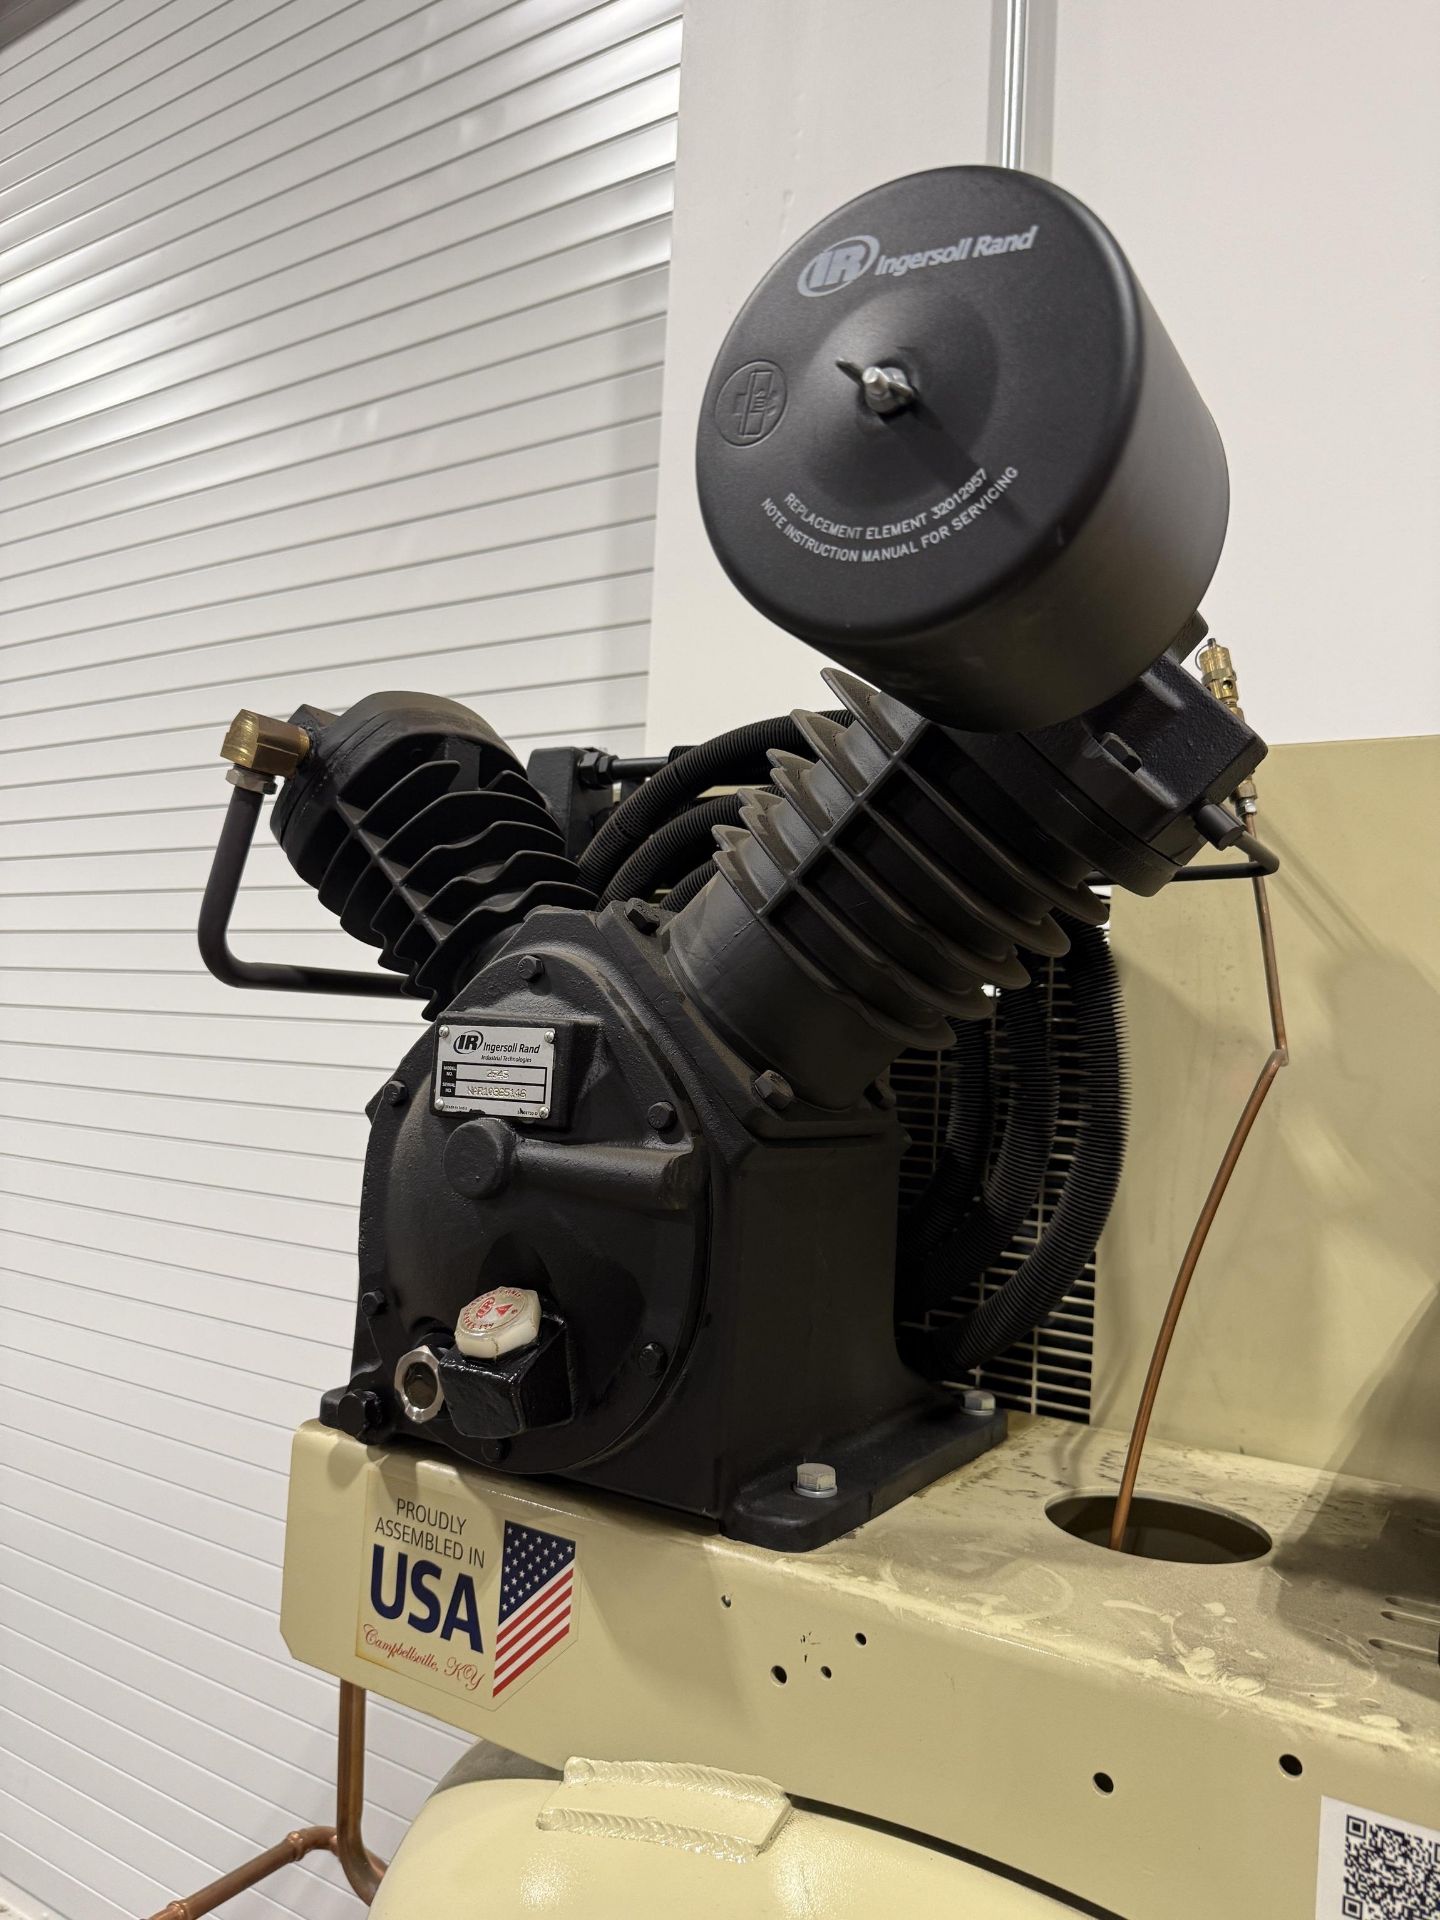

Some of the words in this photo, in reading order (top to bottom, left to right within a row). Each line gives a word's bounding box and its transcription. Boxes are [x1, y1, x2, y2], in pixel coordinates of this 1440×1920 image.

[805, 242, 868, 291] IR
[875, 237, 973, 277] Ingersoll
[972, 225, 1039, 258] Rand
[761, 497, 787, 529] NOTE
[783, 523, 859, 562] INSTRUCTION
[861, 541, 919, 562] MANUAL
[920, 525, 951, 549] FOR
[951, 466, 1019, 531] SERVICING
[784, 492, 863, 539] REPLACEMENT
[865, 512, 927, 540] ELEMENT
[930, 467, 987, 519] 32012957
[457, 1034, 480, 1051] IR
[483, 1042, 517, 1054] Ingersoll
[519, 1044, 541, 1054] Rand
[374, 1517, 464, 1561] ASSEMBLED
[469, 1547, 485, 1569] IN
[396, 1498, 467, 1536] PROUDLY
[370, 1543, 484, 1654] USA
[363, 1624, 439, 1671] Campbellsville,
[444, 1657, 486, 1691] KY
